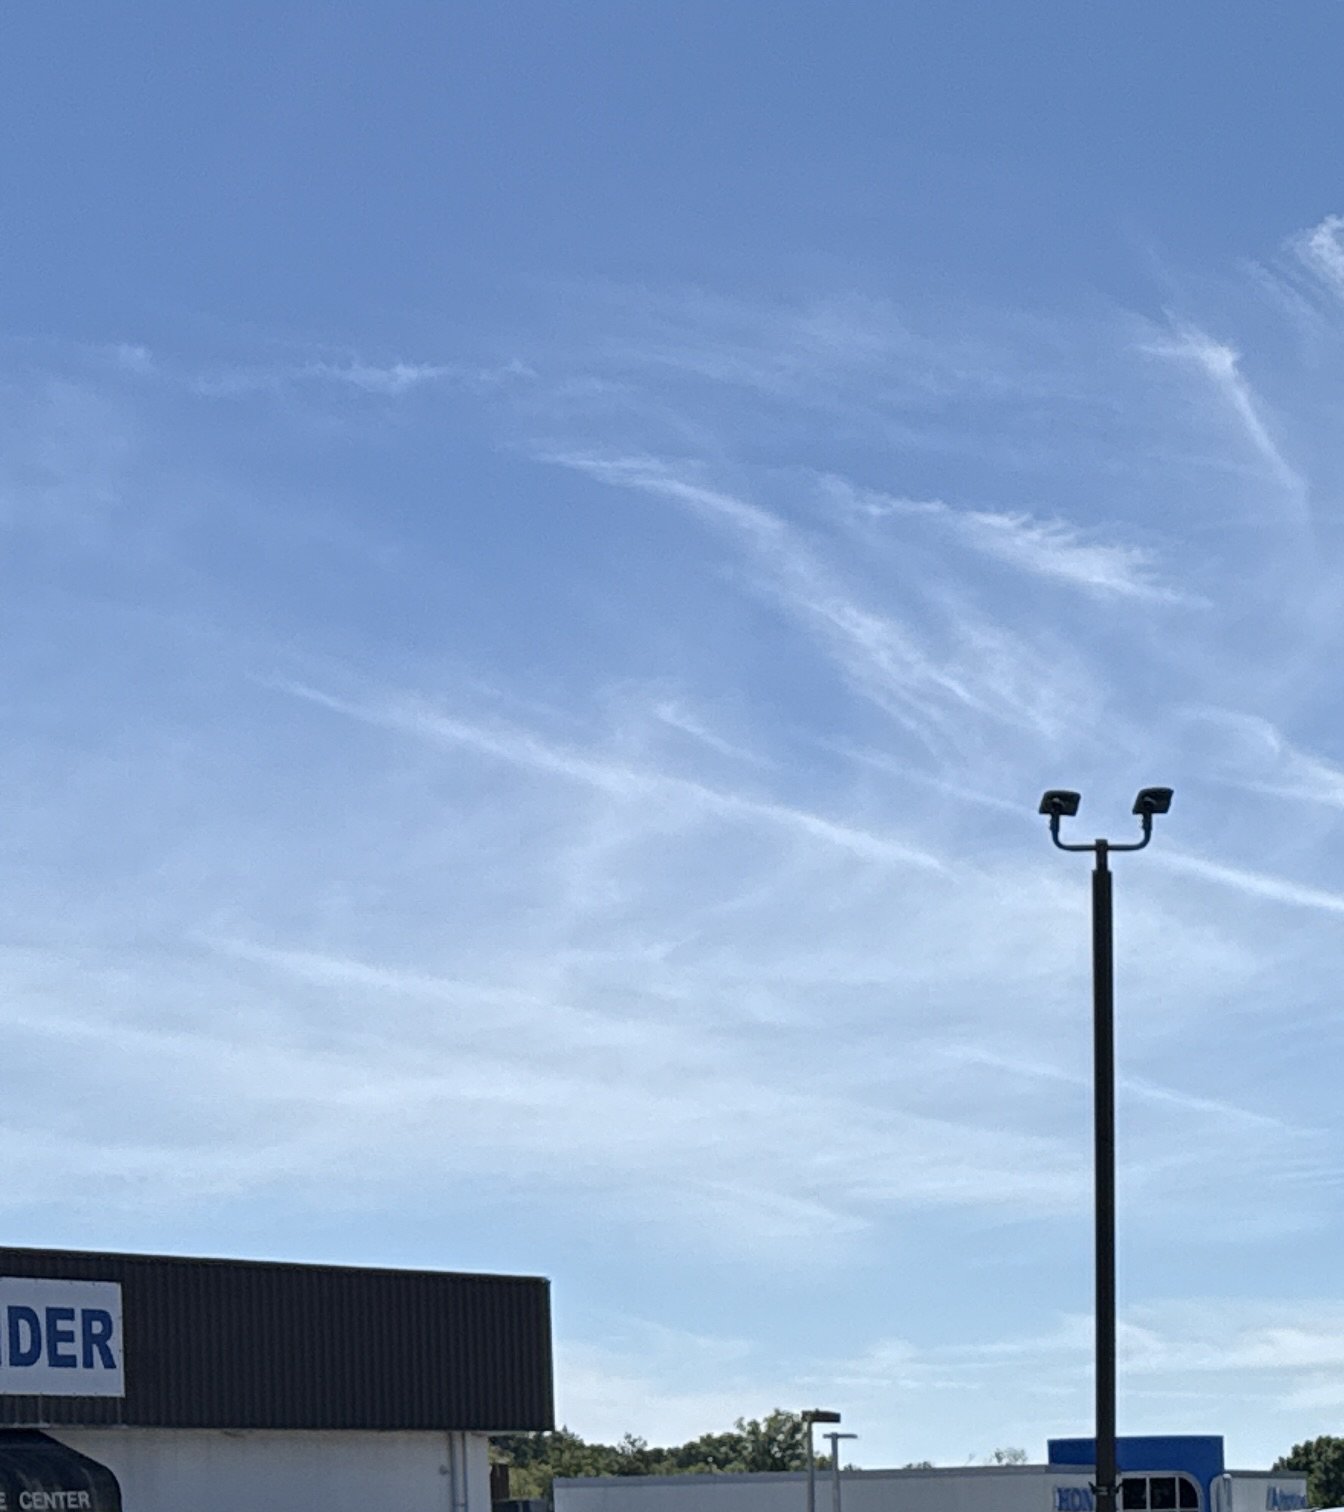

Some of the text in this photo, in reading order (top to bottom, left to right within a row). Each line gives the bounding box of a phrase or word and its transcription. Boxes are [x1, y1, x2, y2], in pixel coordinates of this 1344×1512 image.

[0, 1304, 117, 1370] DER
[19, 1490, 92, 1510] CENTER
[1057, 1487, 1094, 1512] HON
